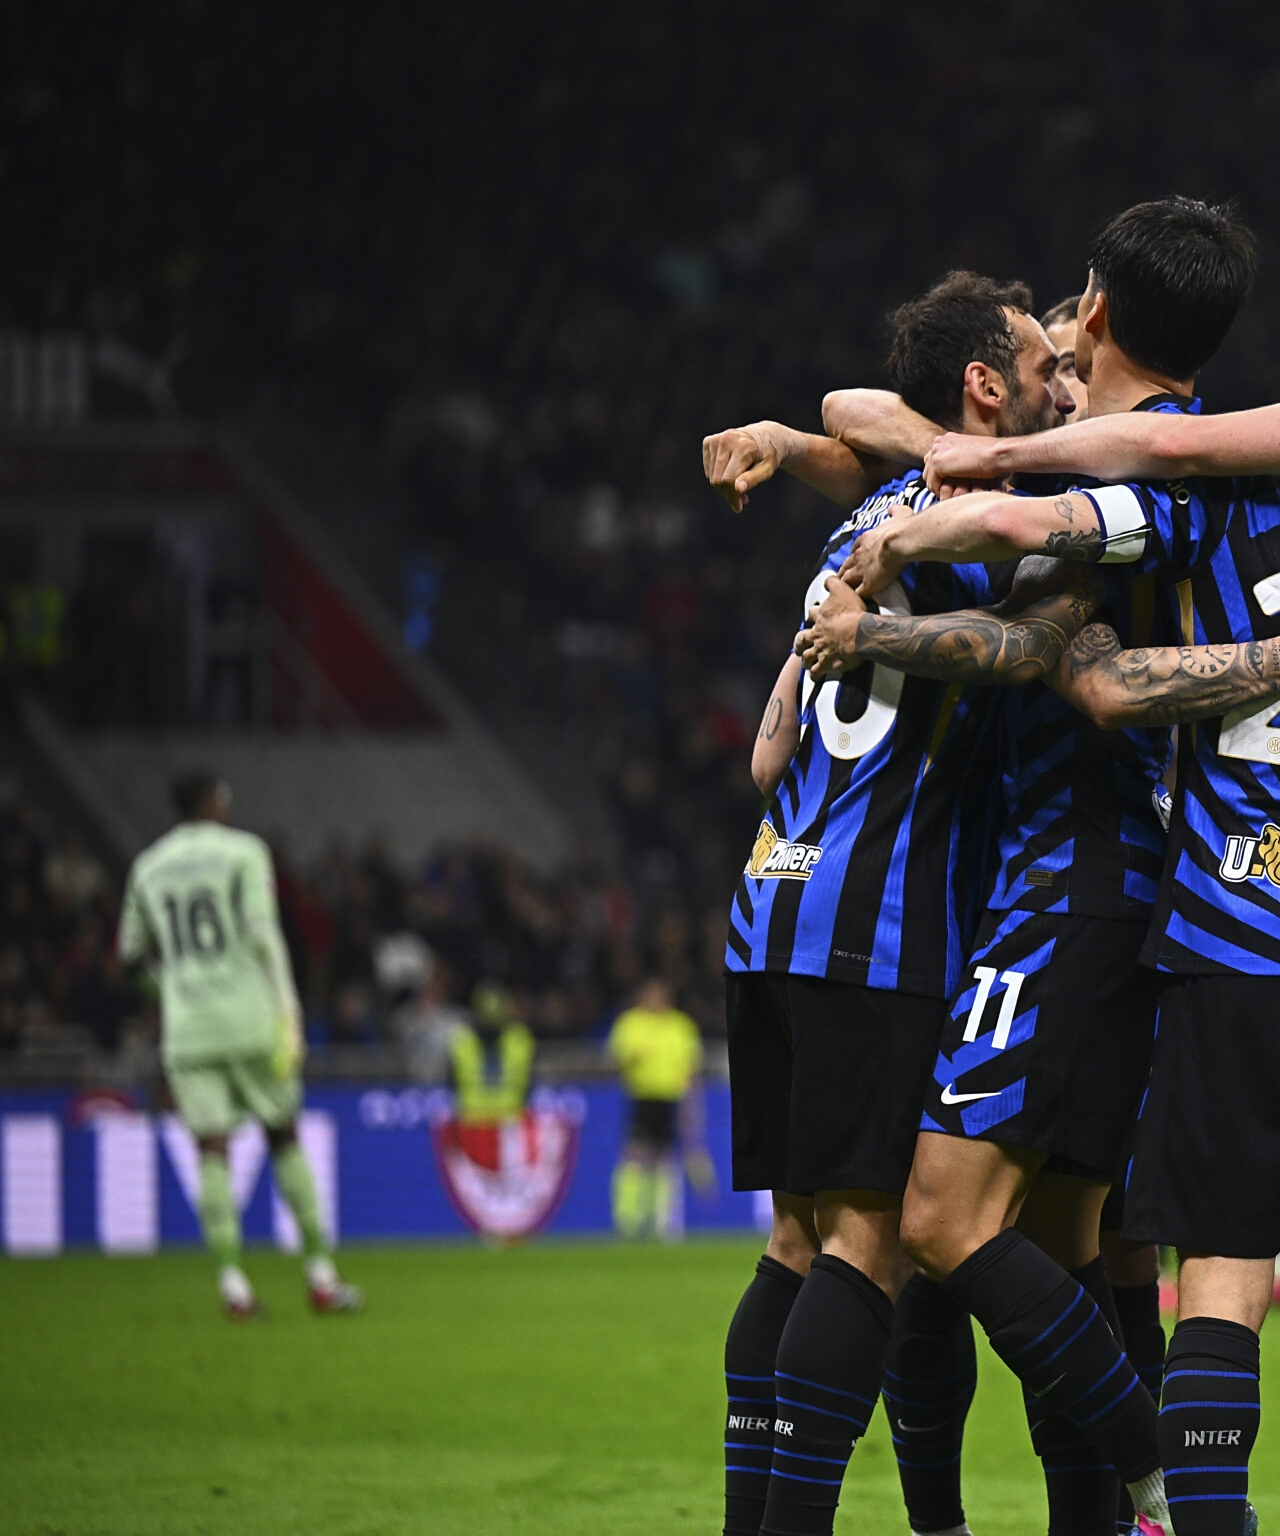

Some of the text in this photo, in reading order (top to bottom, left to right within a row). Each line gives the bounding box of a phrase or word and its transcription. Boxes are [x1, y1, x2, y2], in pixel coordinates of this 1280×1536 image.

[163, 885, 228, 963] 16
[962, 965, 1026, 1050] 11
[728, 1414, 770, 1431] INTER
[1184, 1428, 1242, 1447] INTER
